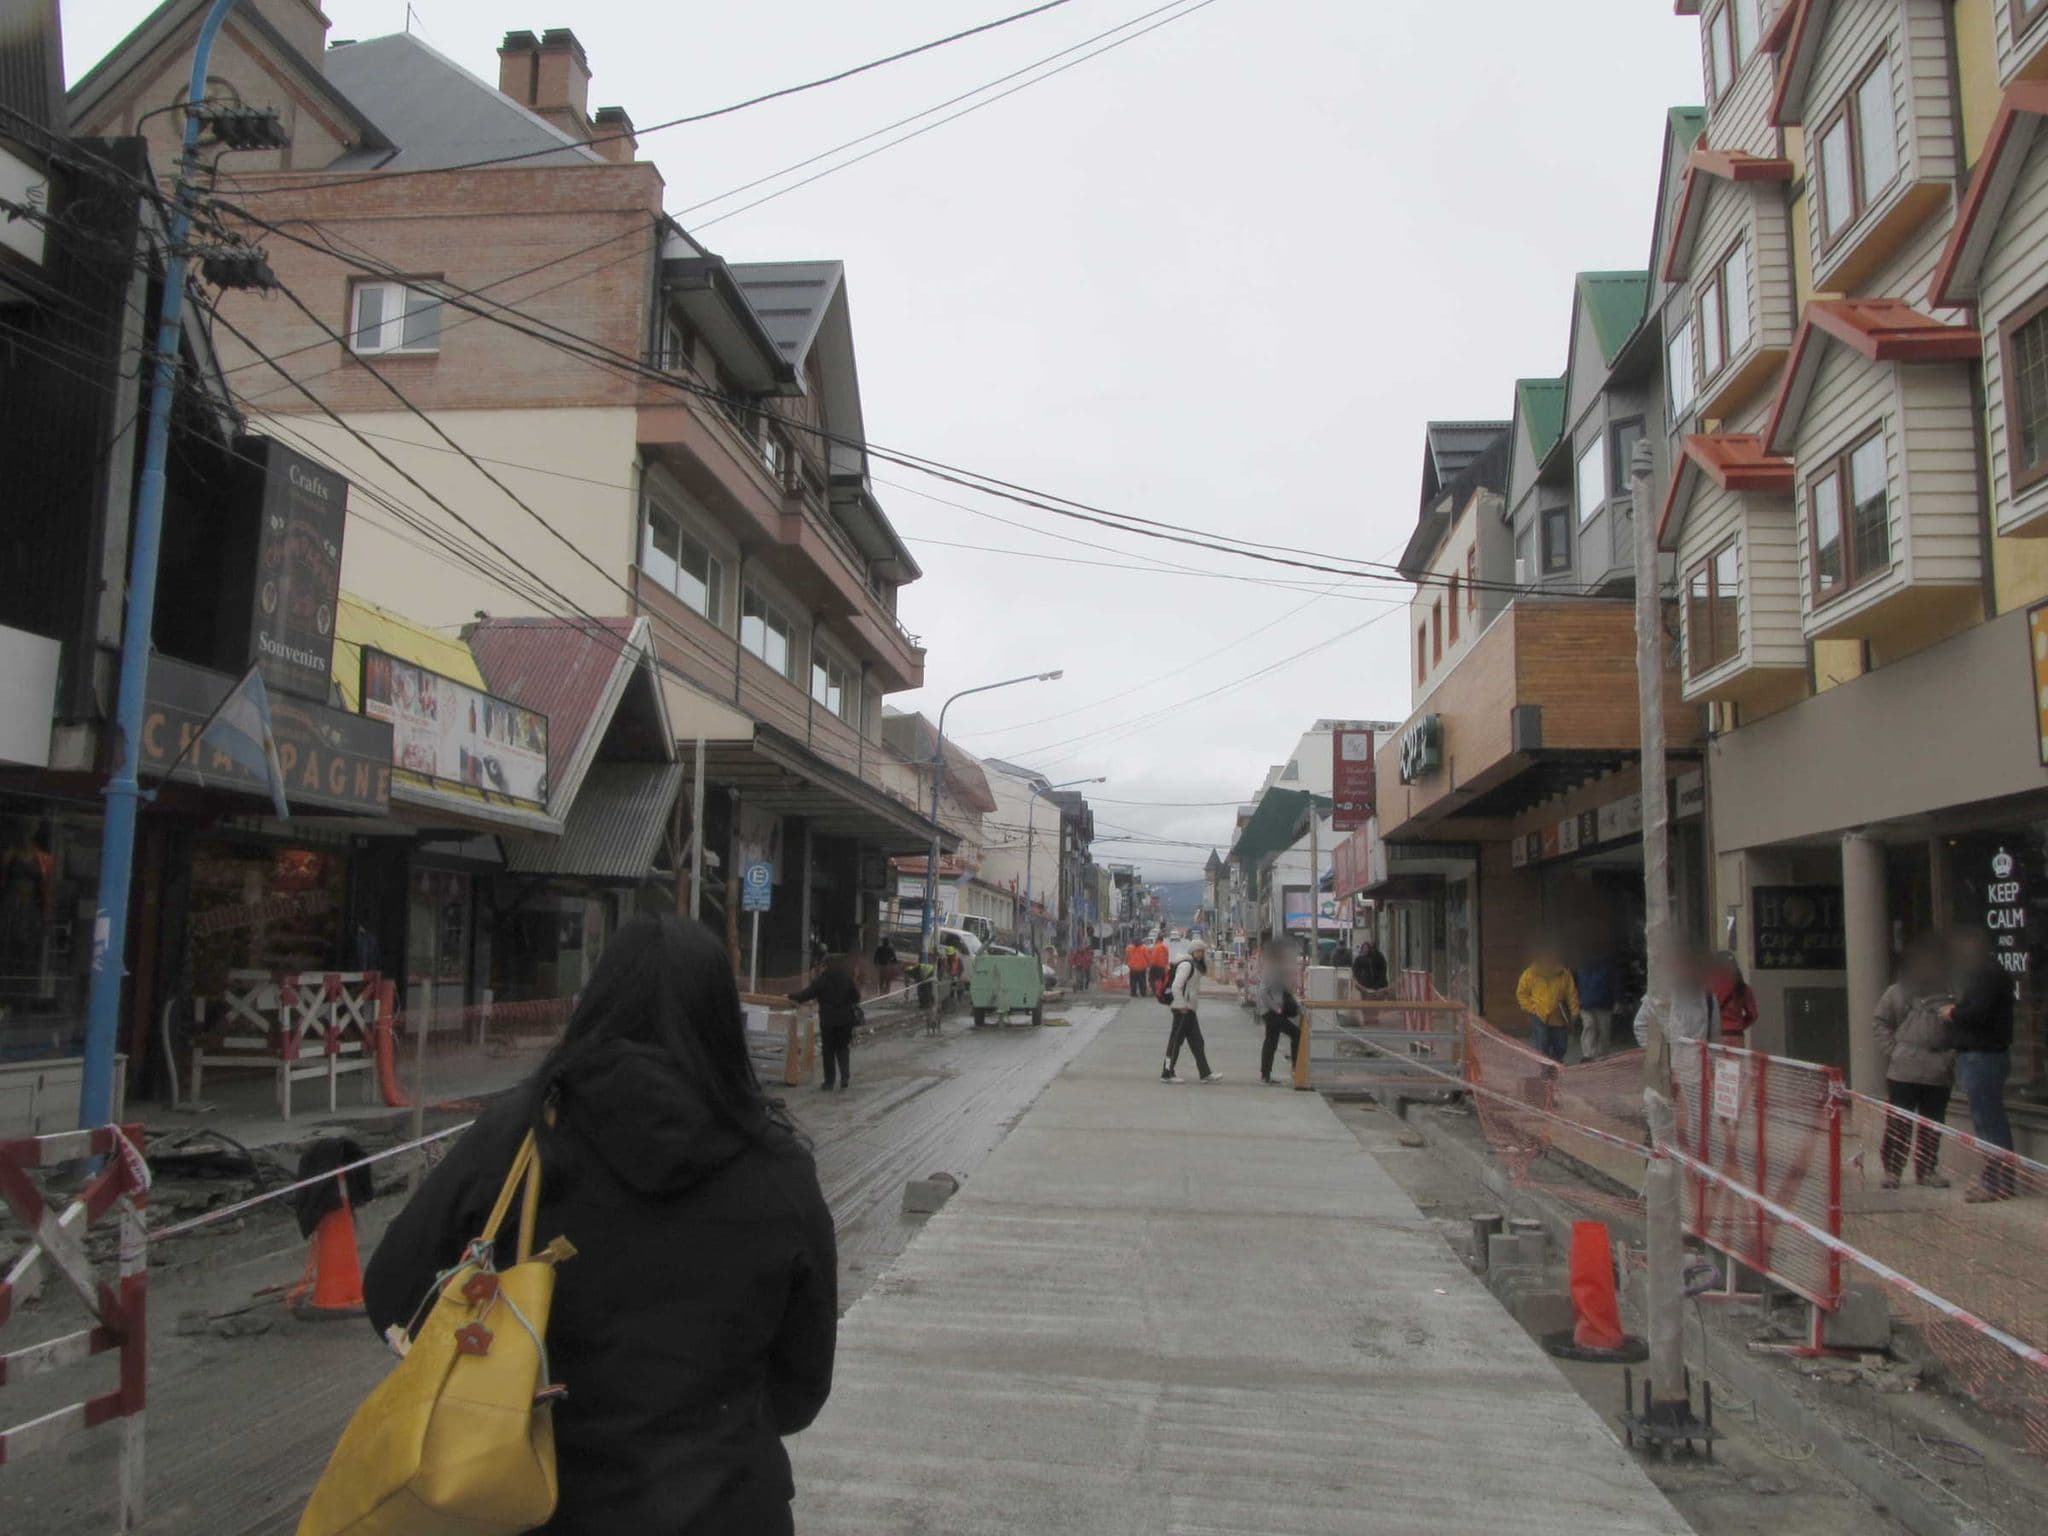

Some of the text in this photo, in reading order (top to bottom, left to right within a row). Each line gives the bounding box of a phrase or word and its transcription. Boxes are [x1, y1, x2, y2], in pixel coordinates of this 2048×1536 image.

[289, 464, 329, 501] Crafts
[259, 631, 326, 672] Souvenirs
[143, 712, 390, 803] CHAPAGNE
[1987, 882, 2019, 903] KEEP
[1987, 908, 2024, 929] CALM
[1998, 936, 2014, 946] AND
[1995, 952, 2028, 972] ARRY
